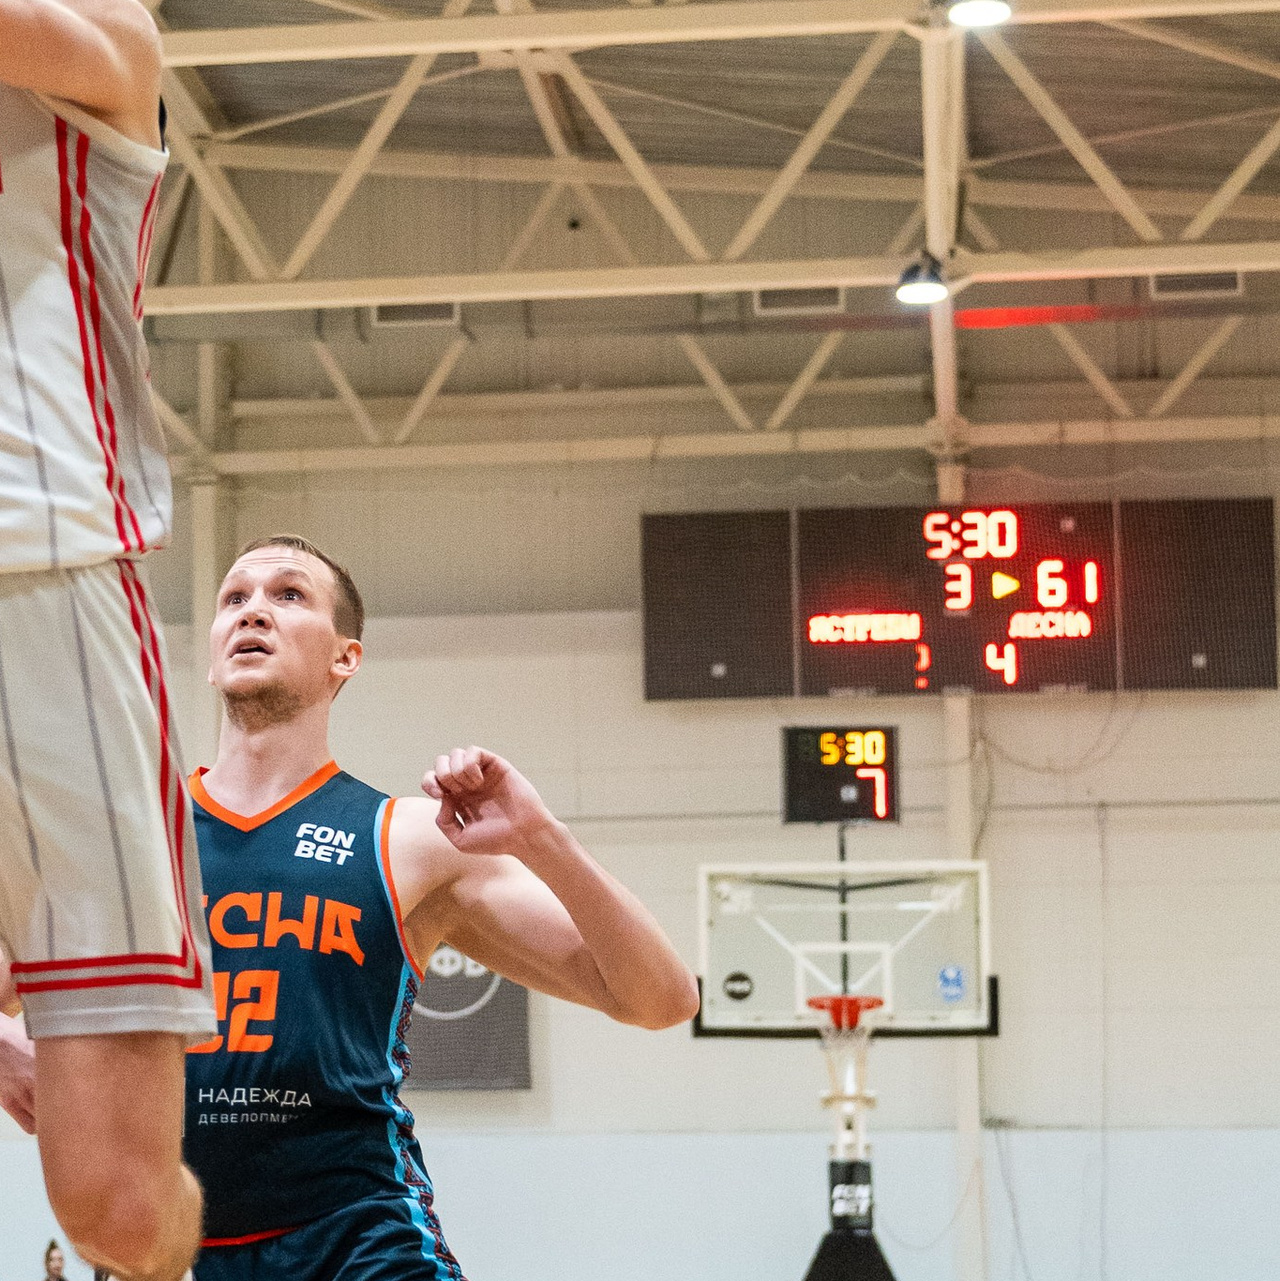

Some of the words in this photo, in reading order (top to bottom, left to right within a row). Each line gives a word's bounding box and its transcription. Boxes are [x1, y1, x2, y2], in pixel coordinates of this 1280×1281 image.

[923, 509, 1018, 560] 5:30
[944, 562, 972, 611] 3
[985, 641, 1018, 686] 4
[820, 731, 886, 766] 5:30
[855, 768, 888, 819] 7
[293, 839, 354, 867] BET
[295, 822, 356, 849] FON
[202, 892, 366, 967] СНА
[198, 1087, 313, 1108] НАДЕЖДА
